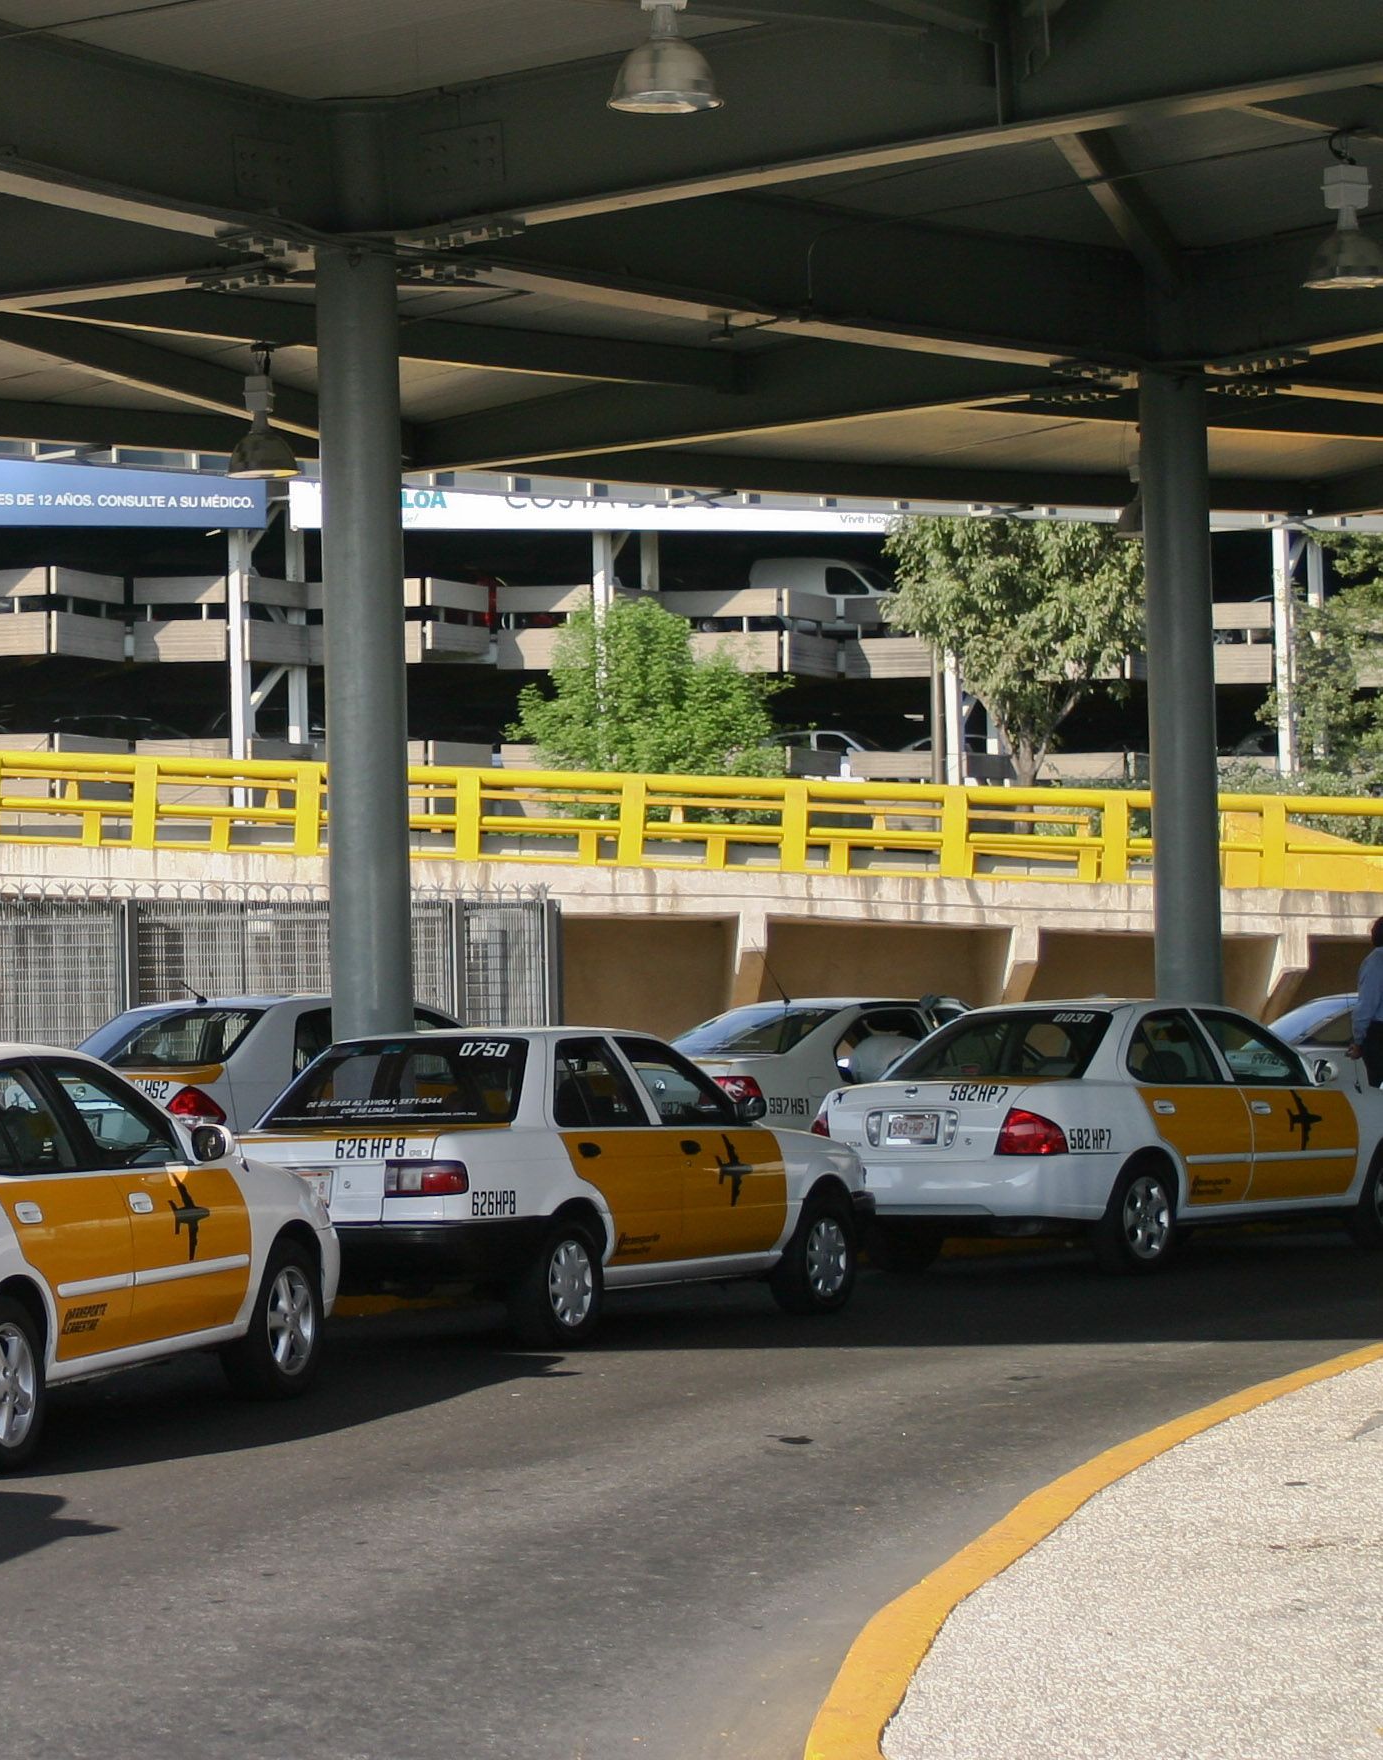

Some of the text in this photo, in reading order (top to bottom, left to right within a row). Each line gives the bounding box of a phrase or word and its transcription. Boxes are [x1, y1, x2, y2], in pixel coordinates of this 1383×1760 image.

[17, 494, 35, 506] DE
[38, 494, 53, 506] 12
[55, 492, 95, 507] AÑOS.
[97, 494, 166, 508] CONSULTE
[167, 496, 178, 508] A
[179, 496, 198, 508] SU
[200, 494, 255, 509] MÉDICO.
[401, 490, 447, 509] LOA
[1052, 1013, 1095, 1024] 0030
[458, 1042, 511, 1058] 0750
[949, 1084, 1009, 1103] 582HP7
[769, 1098, 810, 1115] 997HS1
[1069, 1128, 1112, 1149] 582HP7
[472, 1190, 516, 1216] 626HP8
